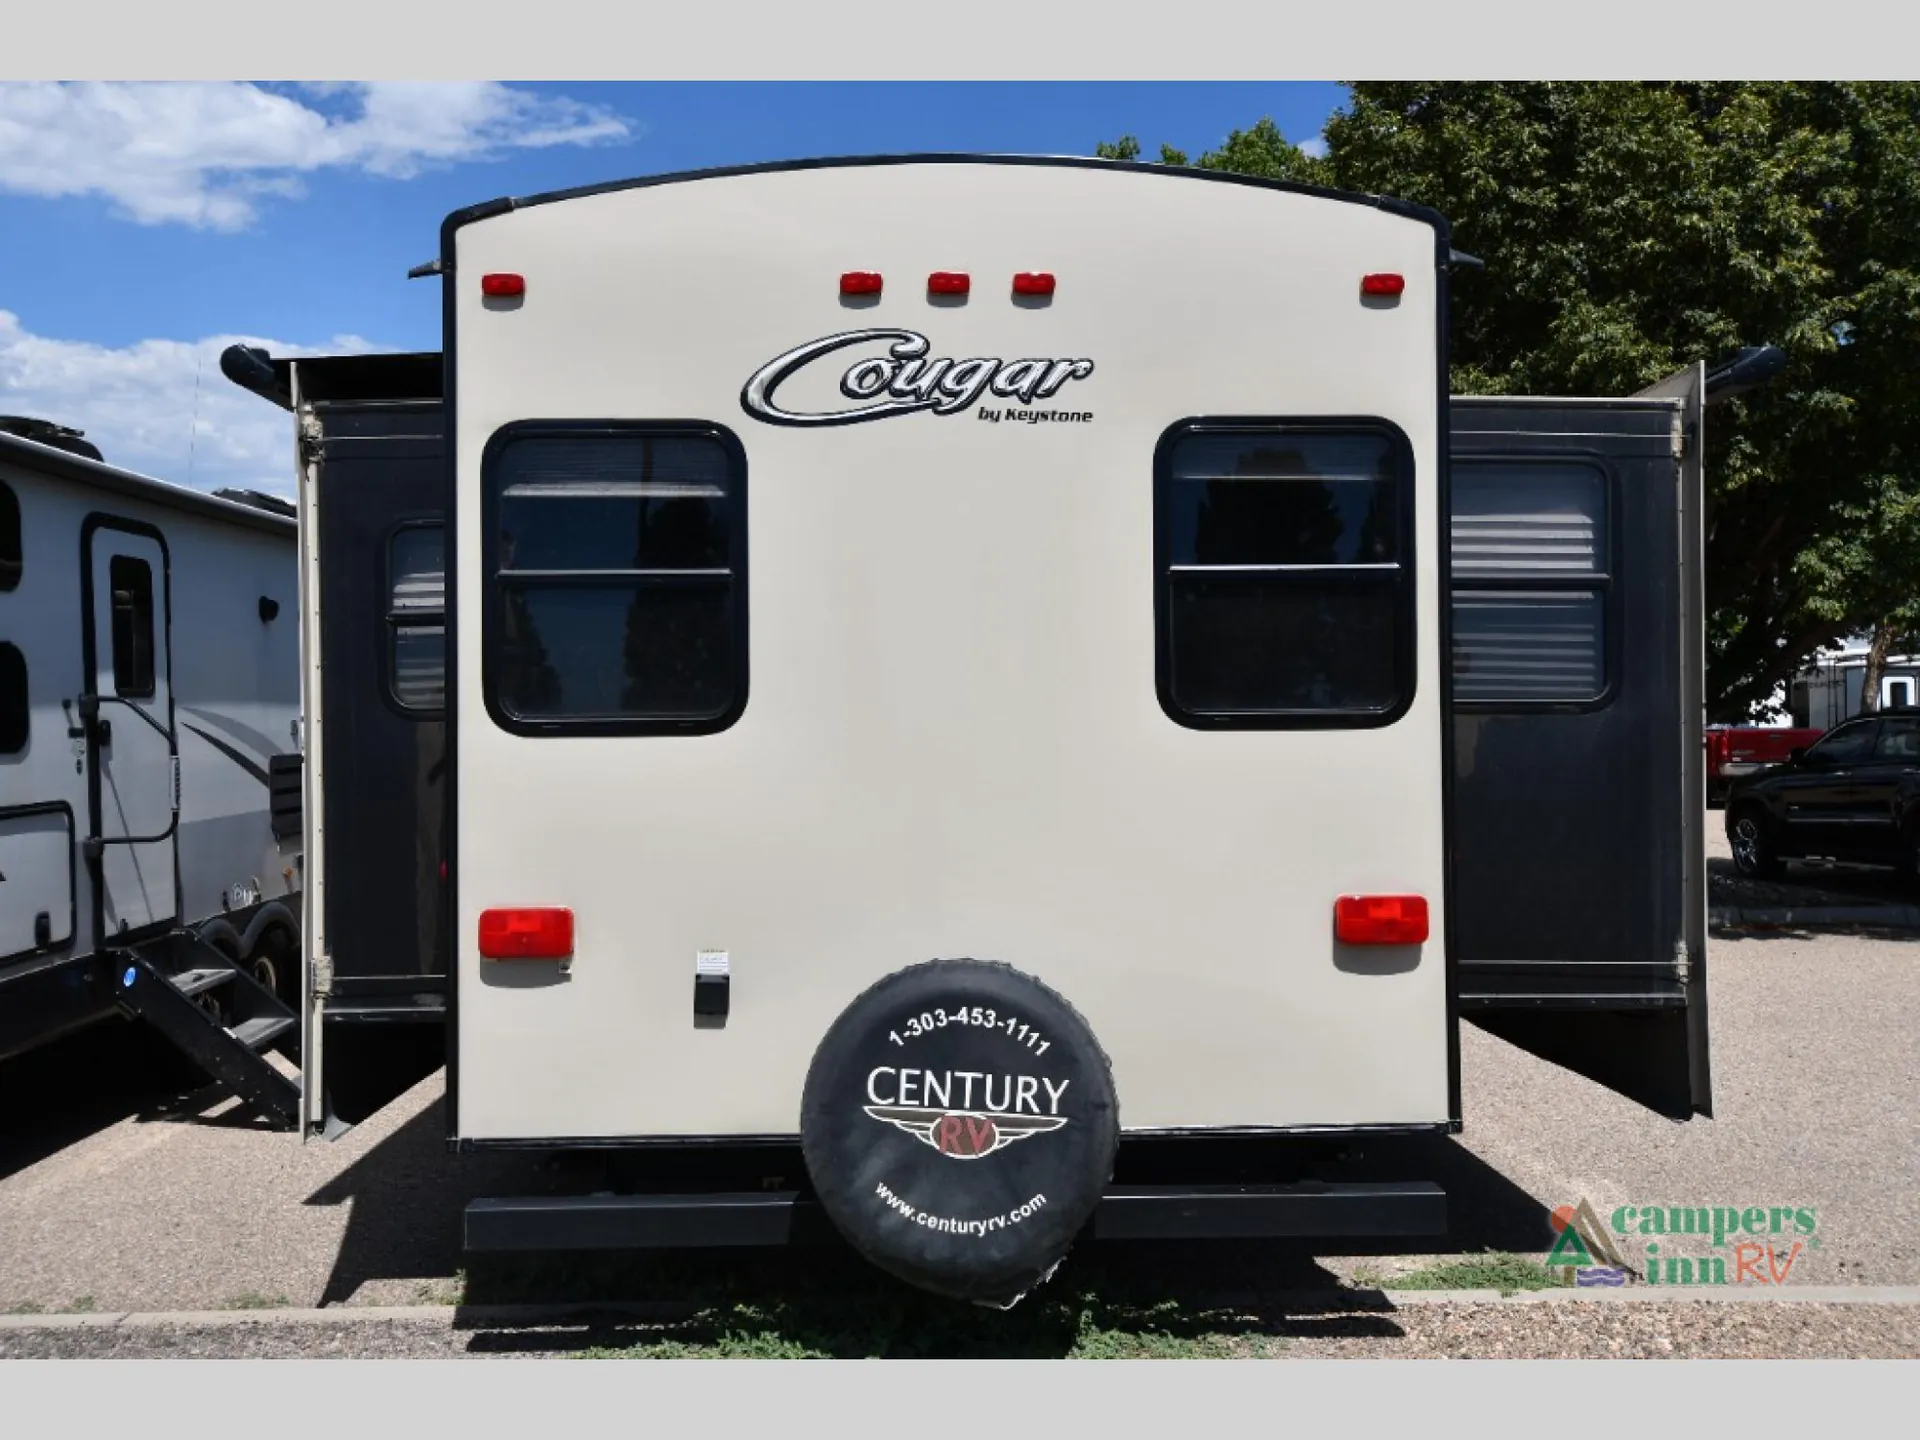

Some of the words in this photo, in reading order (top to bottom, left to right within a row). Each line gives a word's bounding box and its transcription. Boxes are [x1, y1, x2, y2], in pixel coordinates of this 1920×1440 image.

[740, 328, 1094, 427] Cougar
[977, 406, 1000, 423] by
[1005, 407, 1094, 424] Keystone
[889, 1006, 1050, 1056] 1-303-453-1111
[867, 1066, 1070, 1114] CENTURY
[938, 1115, 992, 1154] RV
[875, 1182, 1047, 1237] www.centuryrv.com
